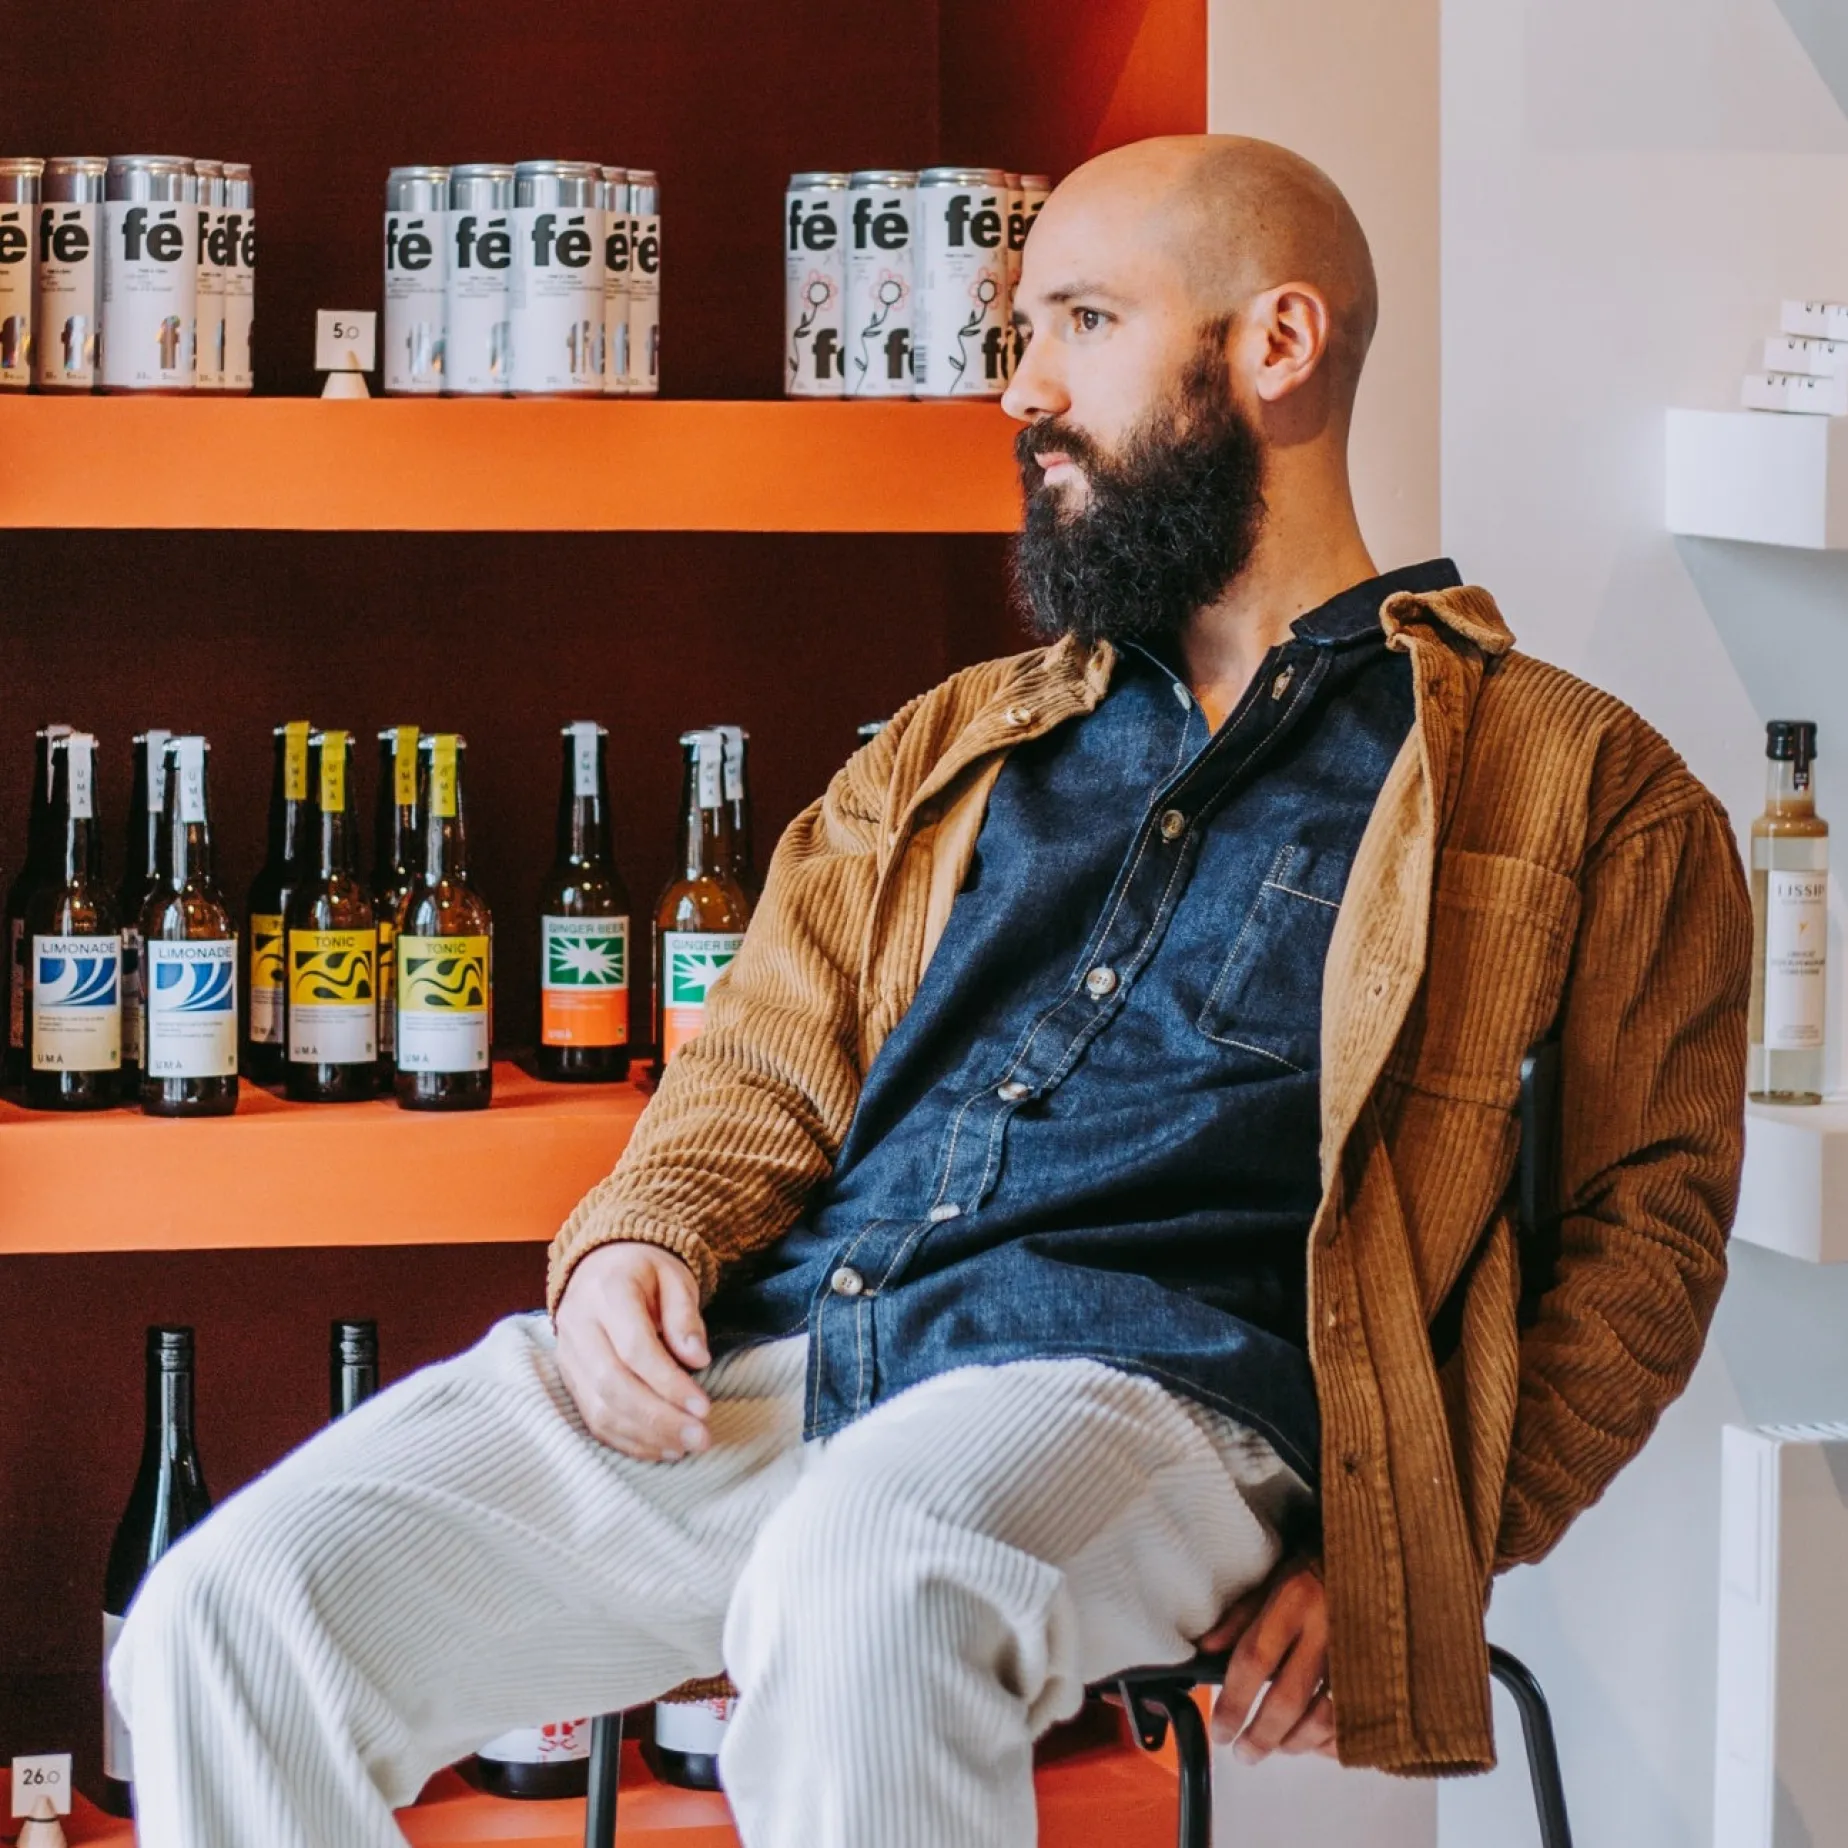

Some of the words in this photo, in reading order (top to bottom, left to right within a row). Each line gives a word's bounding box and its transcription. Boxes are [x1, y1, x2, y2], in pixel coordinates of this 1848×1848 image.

[788, 199, 838, 251] fé
[852, 197, 910, 250] fé
[944, 194, 1002, 249] fé
[40, 208, 90, 263] fé
[121, 207, 183, 262] fé
[387, 217, 433, 271] fé
[455, 216, 511, 270] fé
[531, 213, 592, 268] fé
[76, 769, 86, 805] UMA
[188, 771, 199, 809] UMA
[549, 923, 594, 934] GINGER
[598, 922, 625, 933] BEER
[41, 942, 116, 954] LIMONADE
[159, 946, 233, 959] LIMONADE
[315, 936, 356, 947] TONIC
[425, 943, 467, 954] TONIC
[671, 939, 721, 950] GINGER
[37, 1053, 64, 1064] UMA
[294, 1044, 318, 1055] UMA
[404, 1053, 429, 1063] UMA
[155, 1059, 183, 1070] UMA
